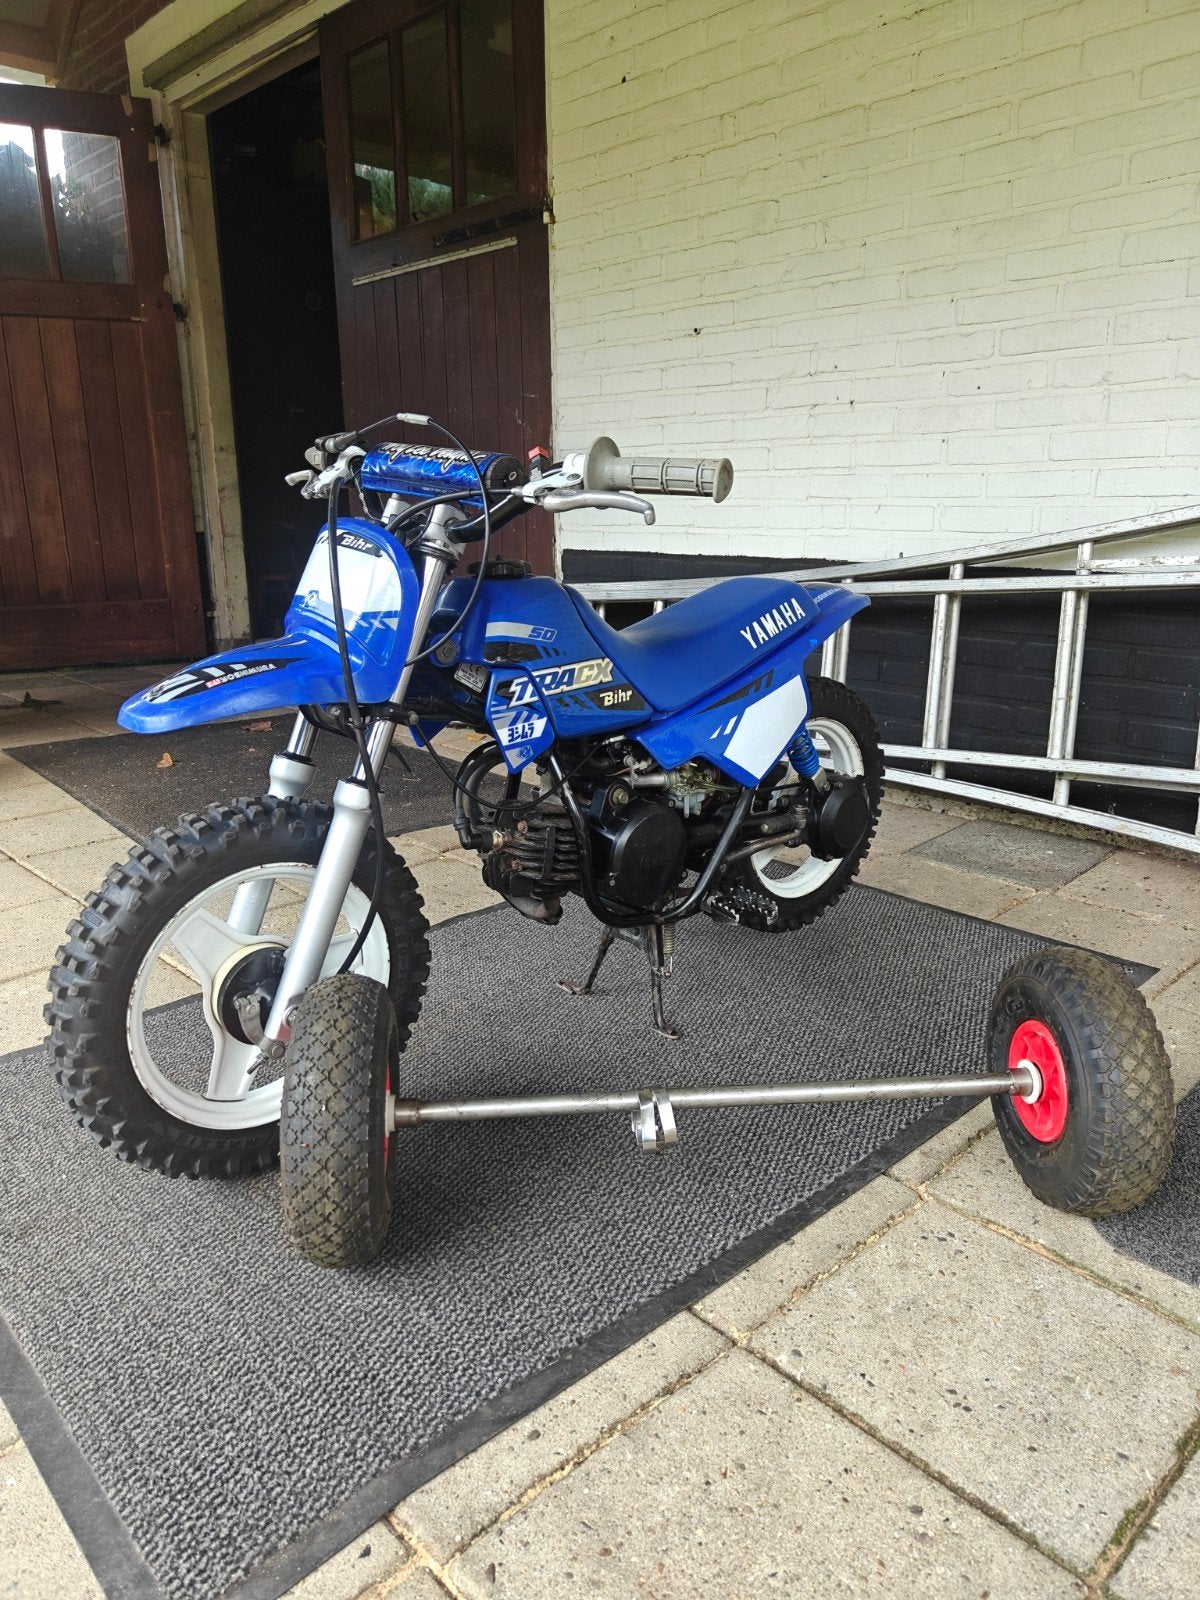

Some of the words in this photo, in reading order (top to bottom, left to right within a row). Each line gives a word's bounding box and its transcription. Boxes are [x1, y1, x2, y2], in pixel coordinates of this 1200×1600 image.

[340, 533, 374, 550] Bihr
[740, 597, 806, 649] YAMAHA
[528, 626, 557, 641] 50
[600, 689, 633, 707] Bihr
